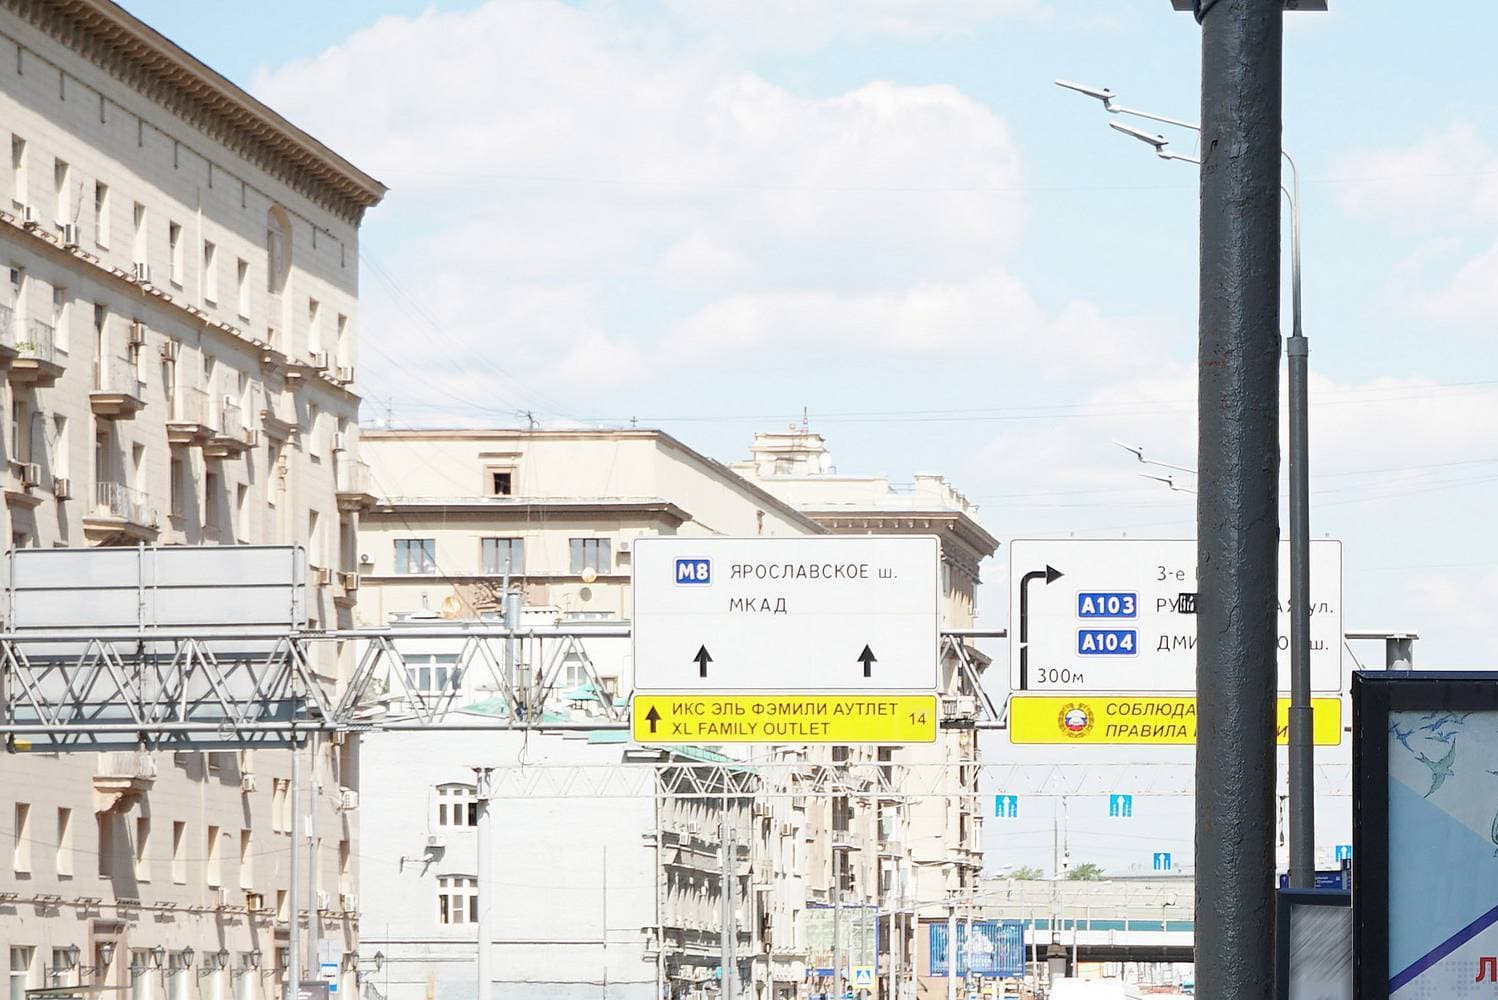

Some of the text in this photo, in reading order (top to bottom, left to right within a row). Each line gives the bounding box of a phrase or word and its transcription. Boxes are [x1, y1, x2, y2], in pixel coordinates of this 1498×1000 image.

[678, 562, 898, 580] М8 ЯРОСЛАВСКОЕ ш.
[1157, 566, 1185, 581] 3-е
[729, 598, 788, 614] МКАД
[1081, 596, 1135, 614] А103
[1081, 633, 1133, 651] А104
[1037, 668, 1084, 683] 300м
[672, 702, 898, 716] ИКС ЭЛЬ ФЭМИЛИ АУТЛЕТ
[1106, 703, 1196, 719] СОБЛЮДА
[908, 712, 927, 726] 14
[672, 722, 831, 736] XL FAMILY OUTLET
[1106, 725, 1187, 737] ПРАВИЛА
